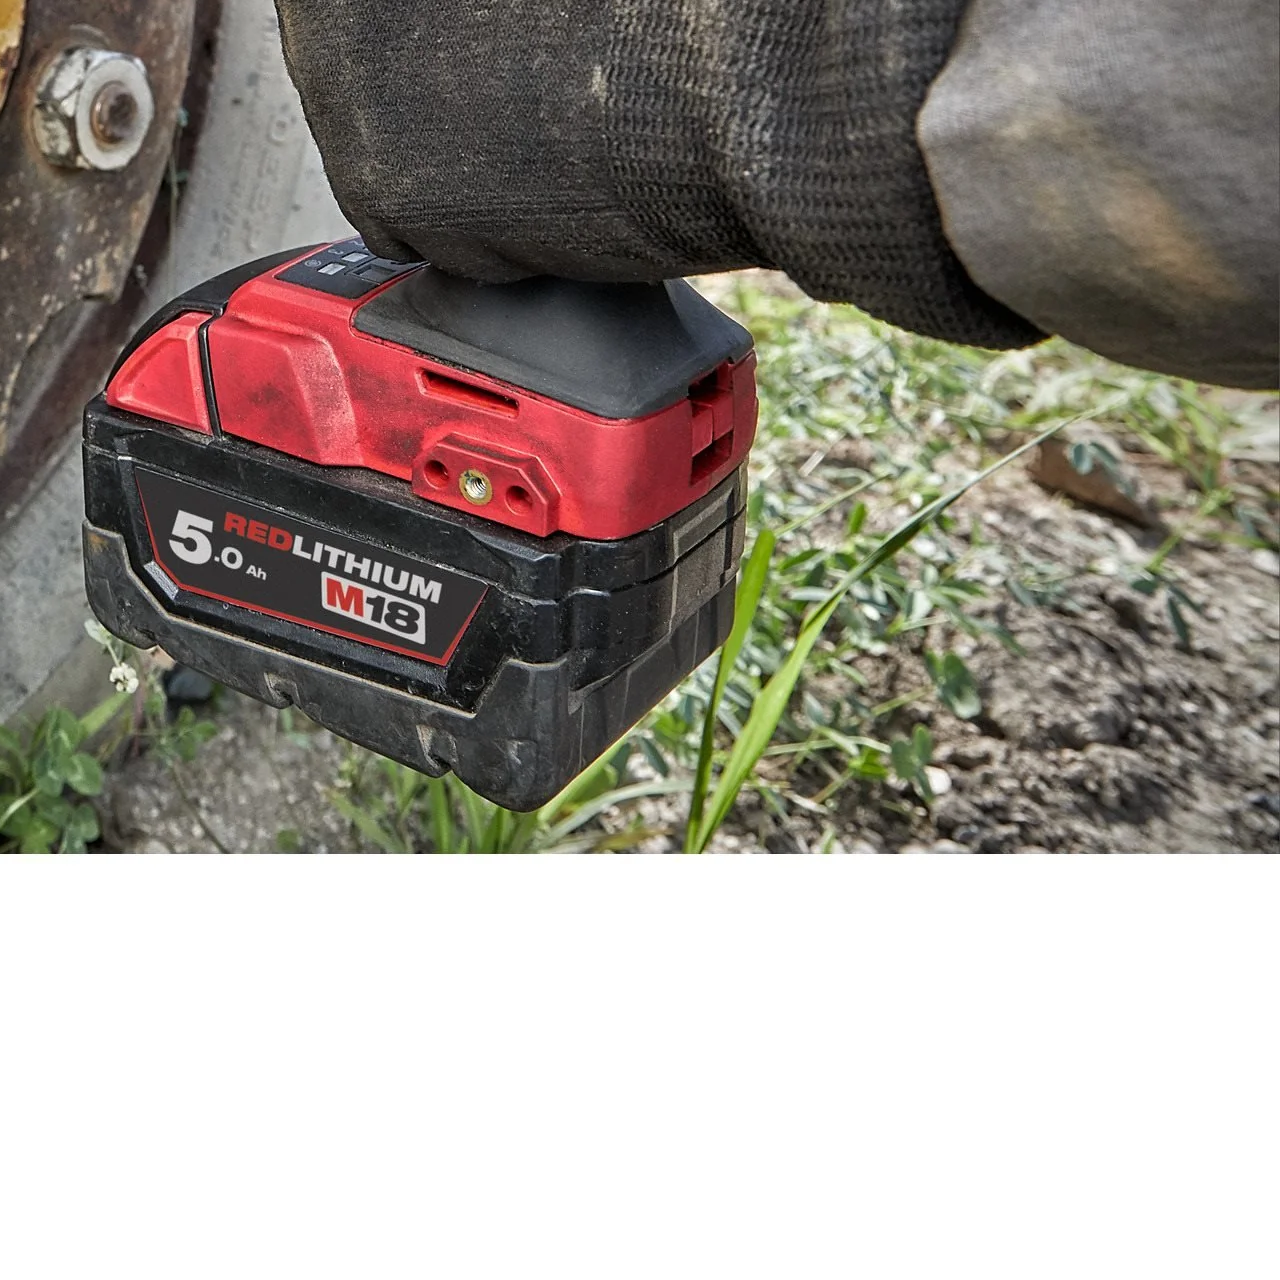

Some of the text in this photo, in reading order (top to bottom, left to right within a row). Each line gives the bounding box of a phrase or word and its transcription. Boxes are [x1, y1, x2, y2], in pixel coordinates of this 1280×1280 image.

[168, 509, 267, 581] 5.0 Ah
[223, 511, 443, 604] REDLITHIUM
[325, 577, 421, 636] M18
